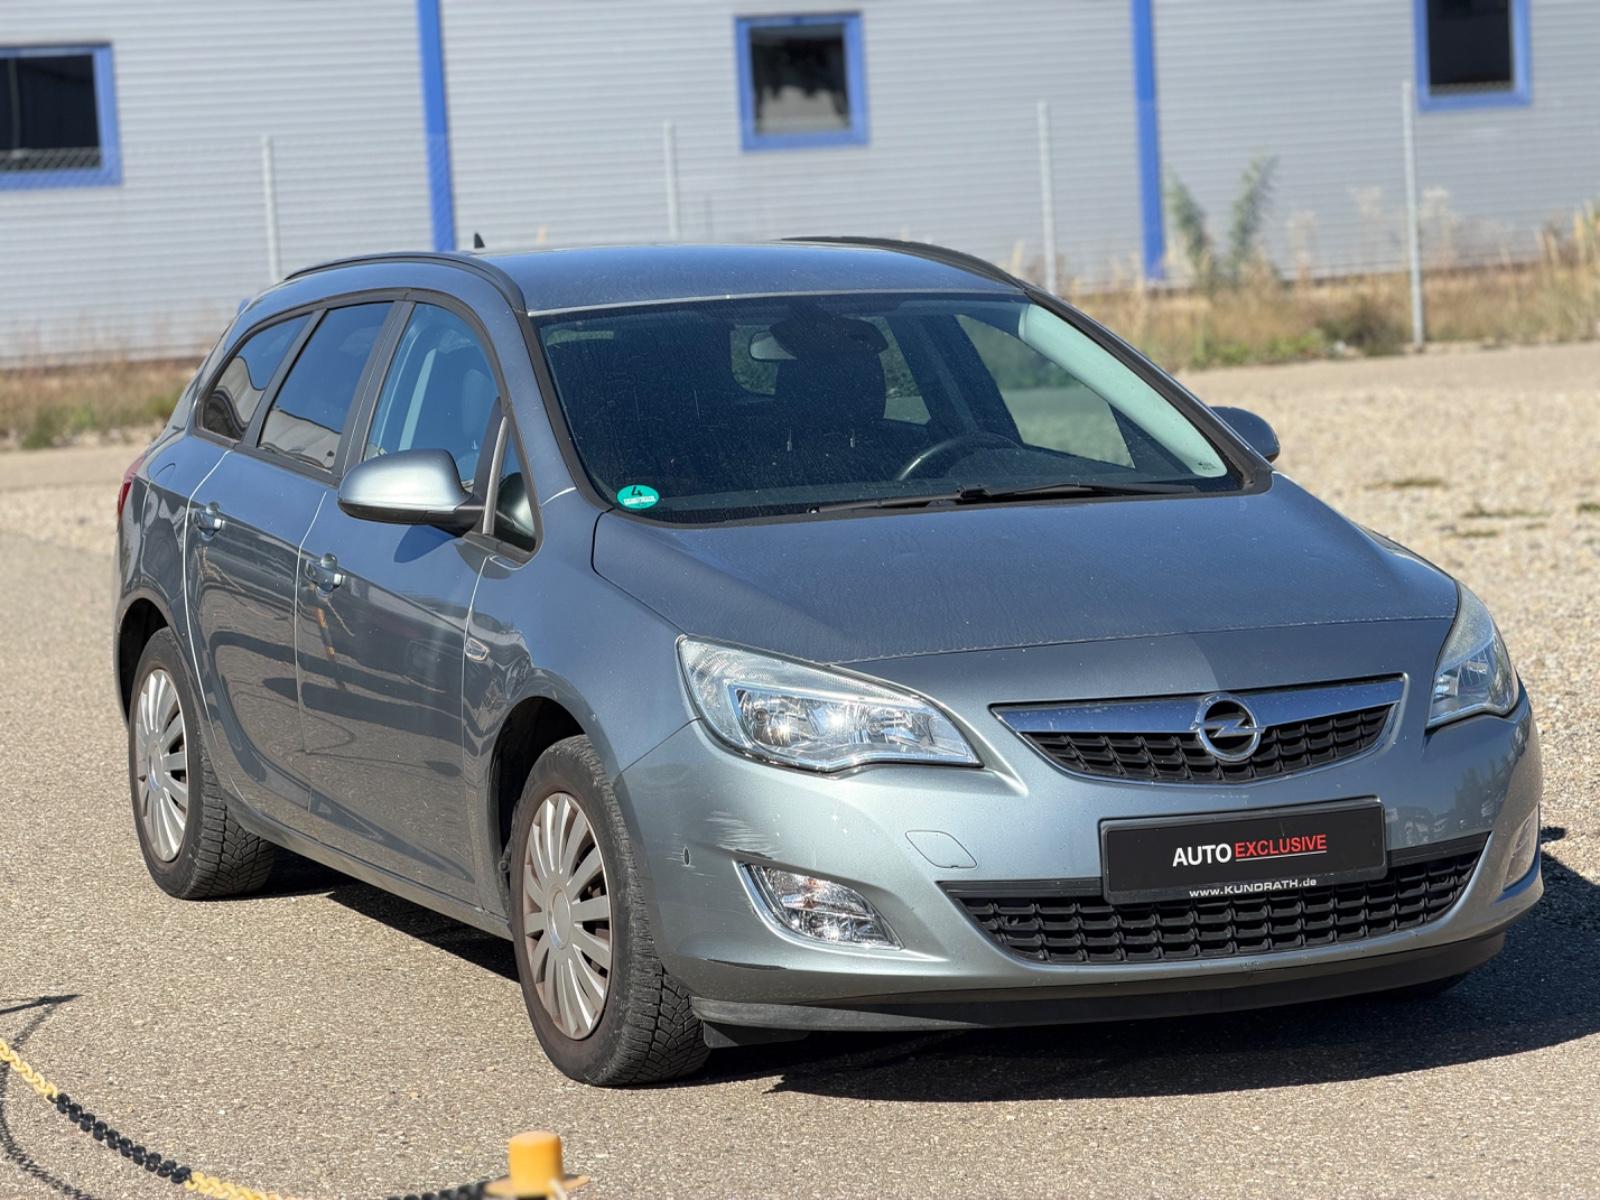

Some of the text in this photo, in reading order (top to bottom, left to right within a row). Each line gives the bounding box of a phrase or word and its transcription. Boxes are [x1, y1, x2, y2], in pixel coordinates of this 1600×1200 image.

[631, 486, 643, 496] 4
[1172, 834, 1327, 867] AUTO EXCLUSIVE
[1189, 878, 1317, 897] www.KUNDRATH.de
